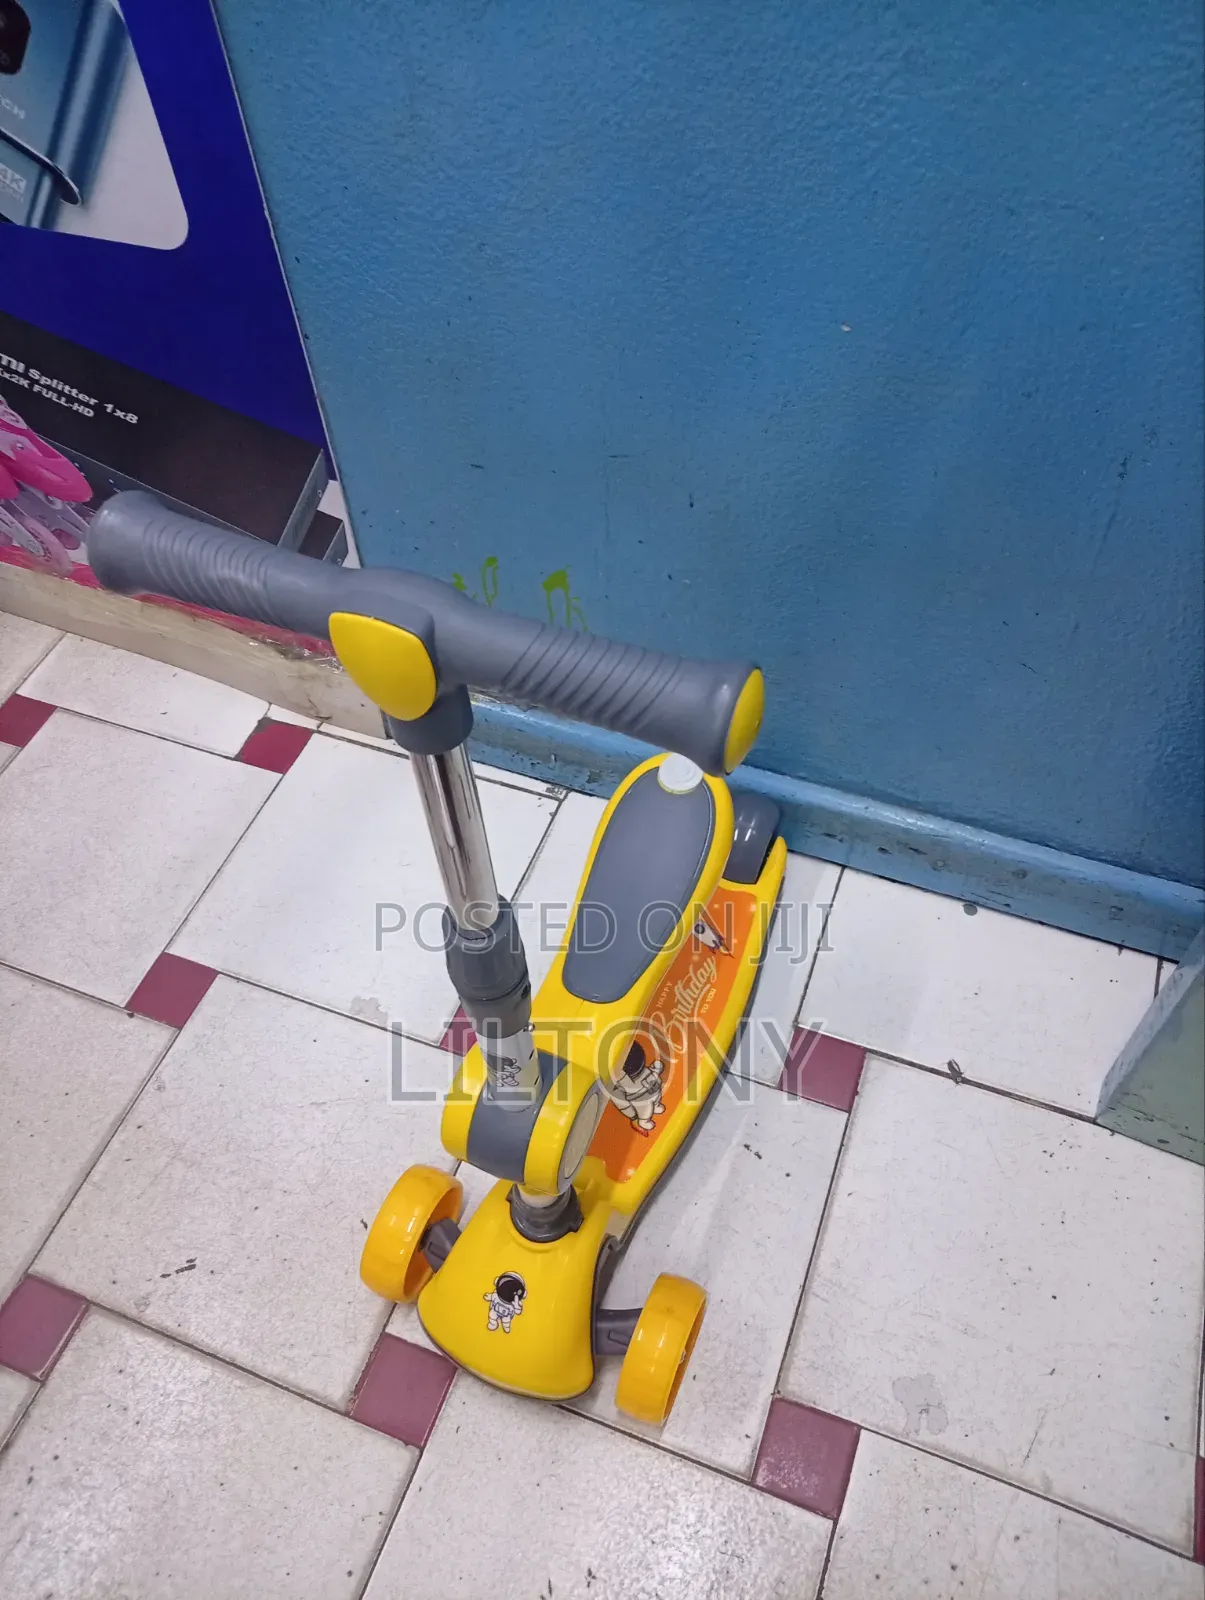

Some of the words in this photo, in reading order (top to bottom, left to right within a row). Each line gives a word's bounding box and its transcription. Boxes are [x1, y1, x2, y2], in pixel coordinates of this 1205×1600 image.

[27, 368, 99, 406] Splitter
[103, 403, 139, 424] 1x8
[32, 384, 95, 417] FULL-HD
[648, 955, 717, 1056] Birthday
[656, 980, 673, 1008] HAPPY
[706, 987, 717, 1003] YOU
